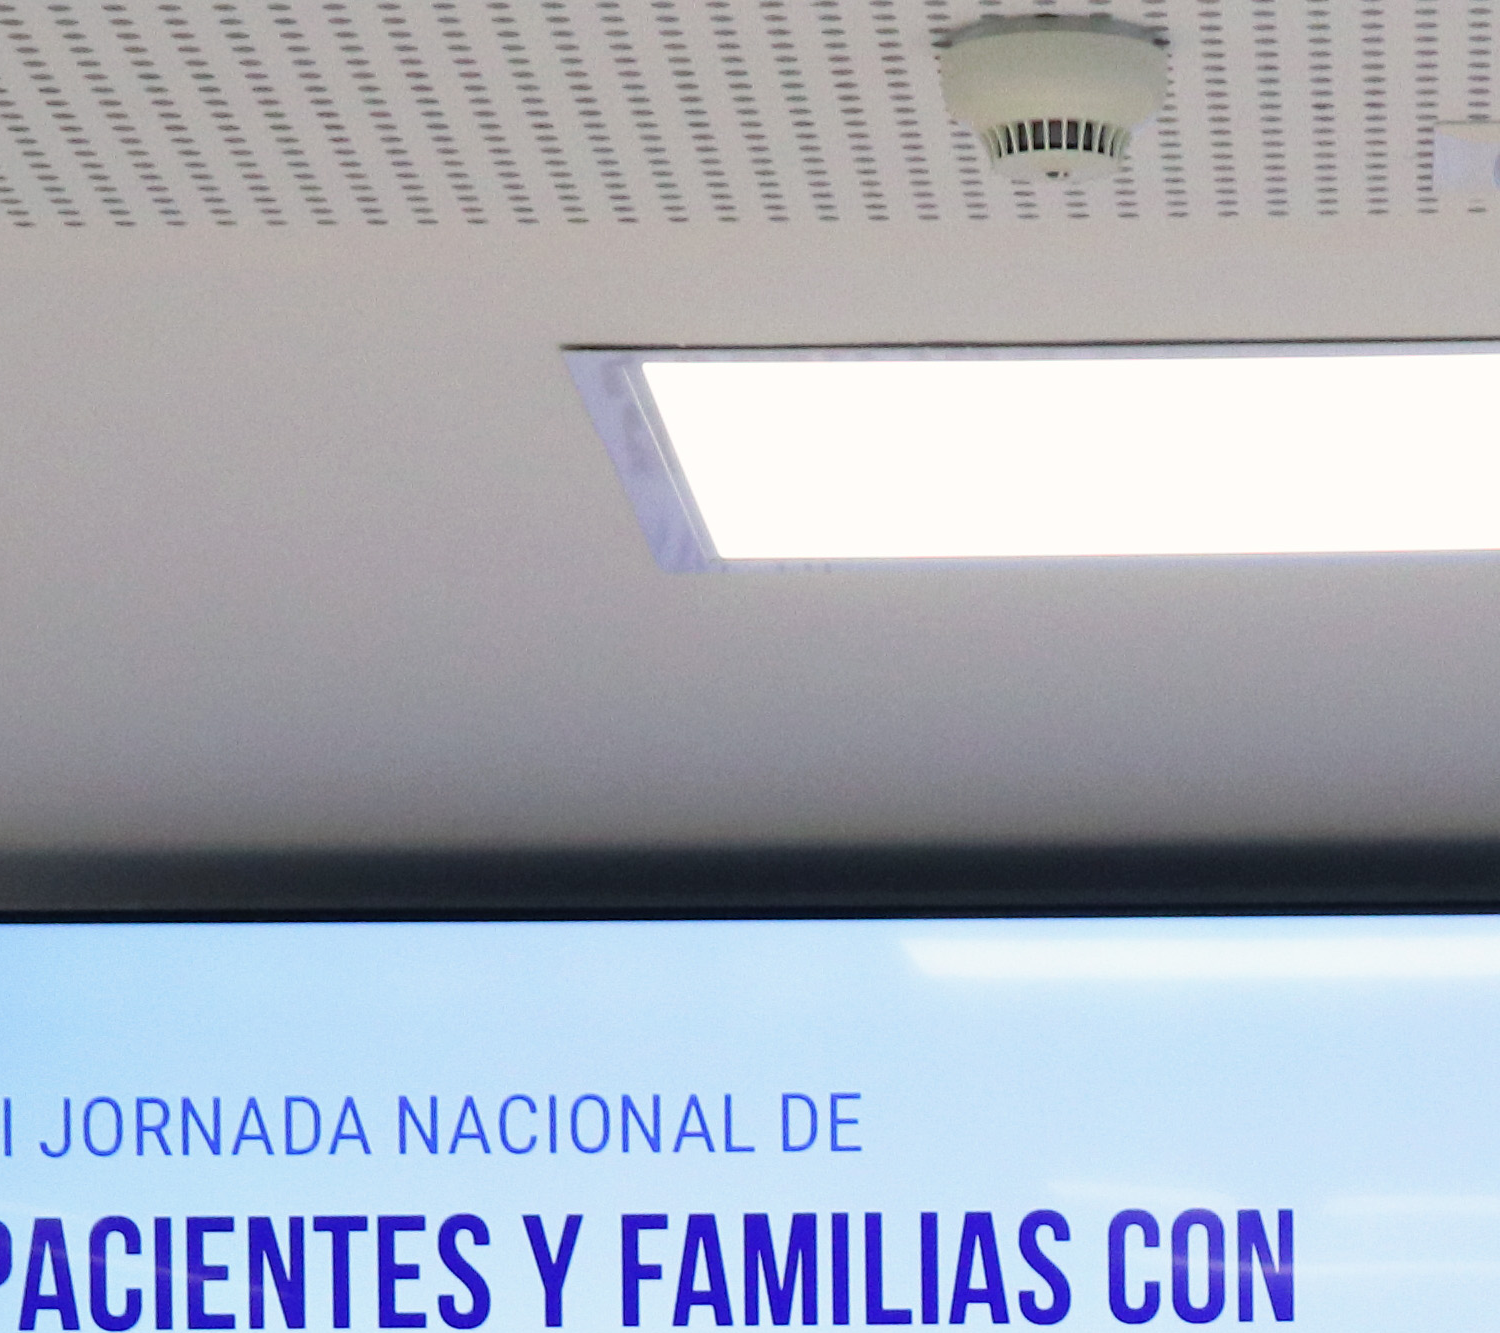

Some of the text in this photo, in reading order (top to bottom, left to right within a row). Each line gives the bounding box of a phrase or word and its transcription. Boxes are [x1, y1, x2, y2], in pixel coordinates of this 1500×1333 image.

[40, 1097, 371, 1158] JORNADA
[399, 1094, 755, 1154] NACIONAL
[782, 1093, 861, 1152] DE
[523, 1214, 583, 1327] Y
[621, 1210, 1071, 1327] FAMILIAS
[1108, 1209, 1294, 1324] CON
